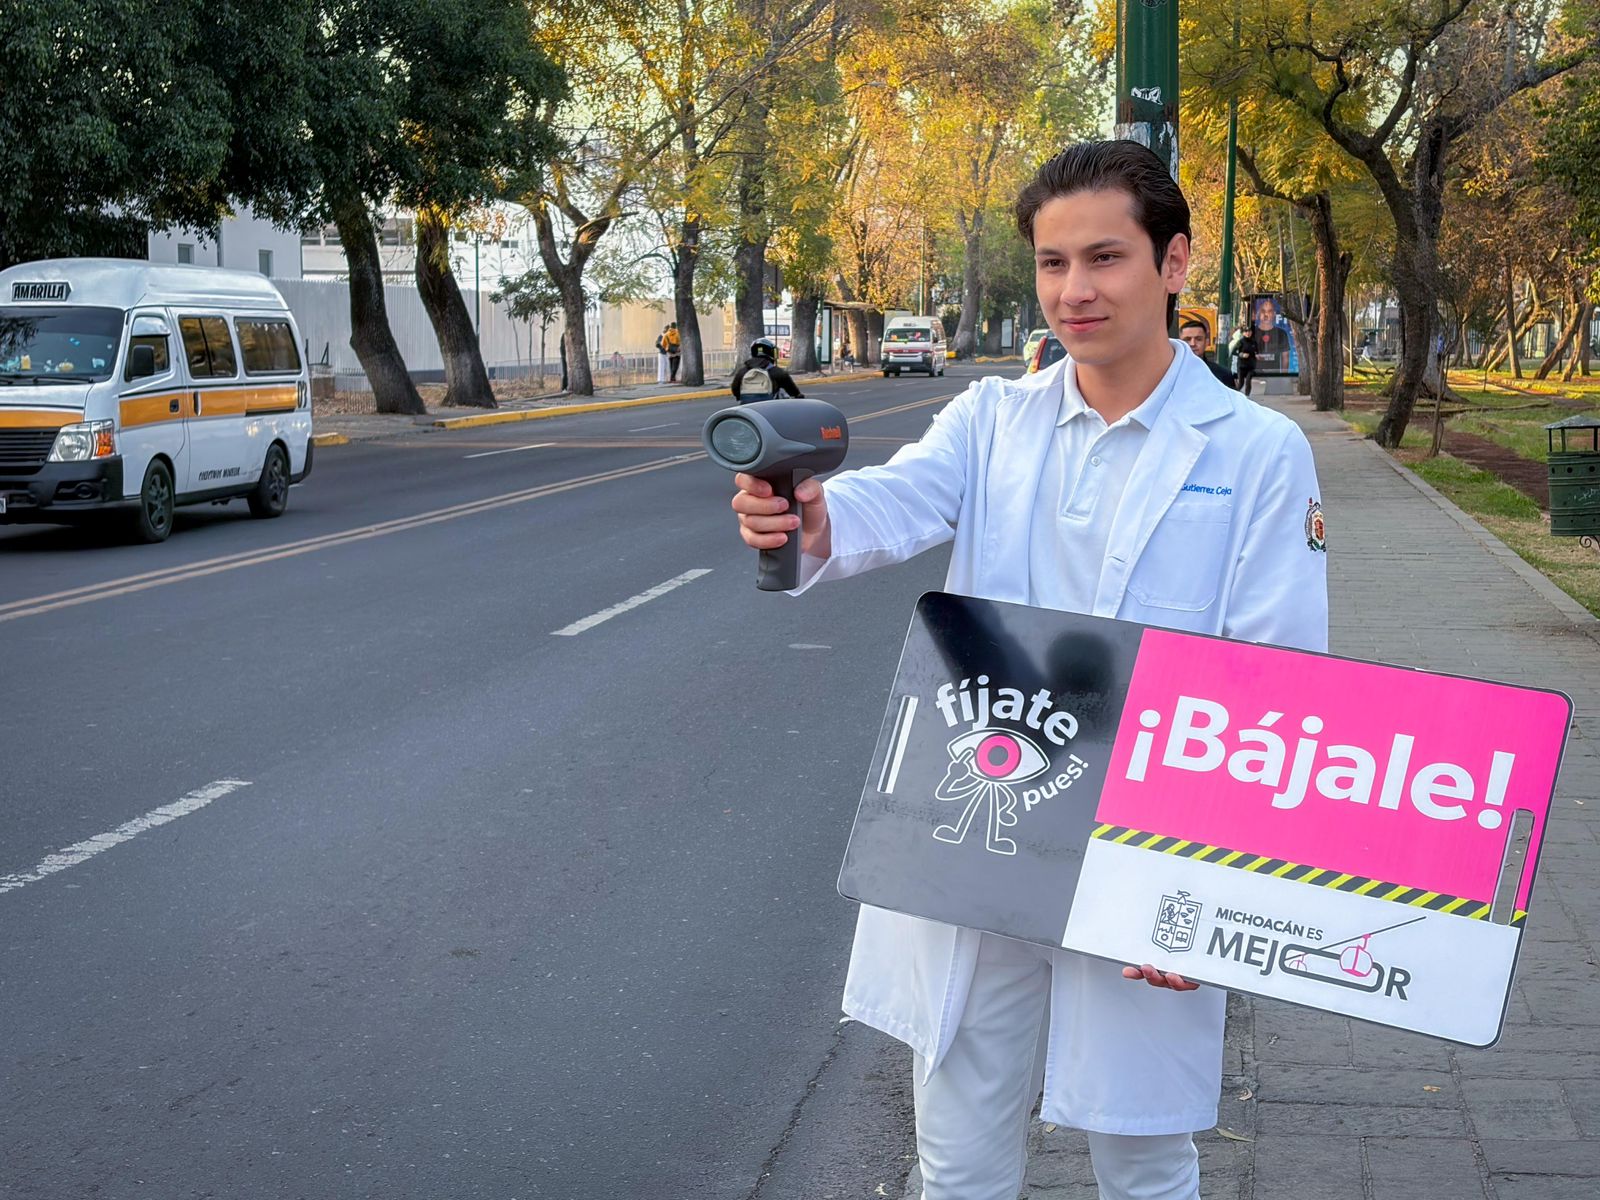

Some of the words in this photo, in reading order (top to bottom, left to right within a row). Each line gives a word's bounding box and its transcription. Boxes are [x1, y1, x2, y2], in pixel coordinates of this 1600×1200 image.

[13, 284, 65, 299] AMARILLA
[1215, 486, 1232, 496] Ceja
[935, 674, 1079, 746] fíjate
[1022, 753, 1089, 812] pues!
[1125, 695, 1516, 830] ¡Bájale!
[1215, 906, 1305, 937] MICHOACÁN
[1306, 927, 1324, 941] ES
[1205, 926, 1413, 1001] MEJOR
